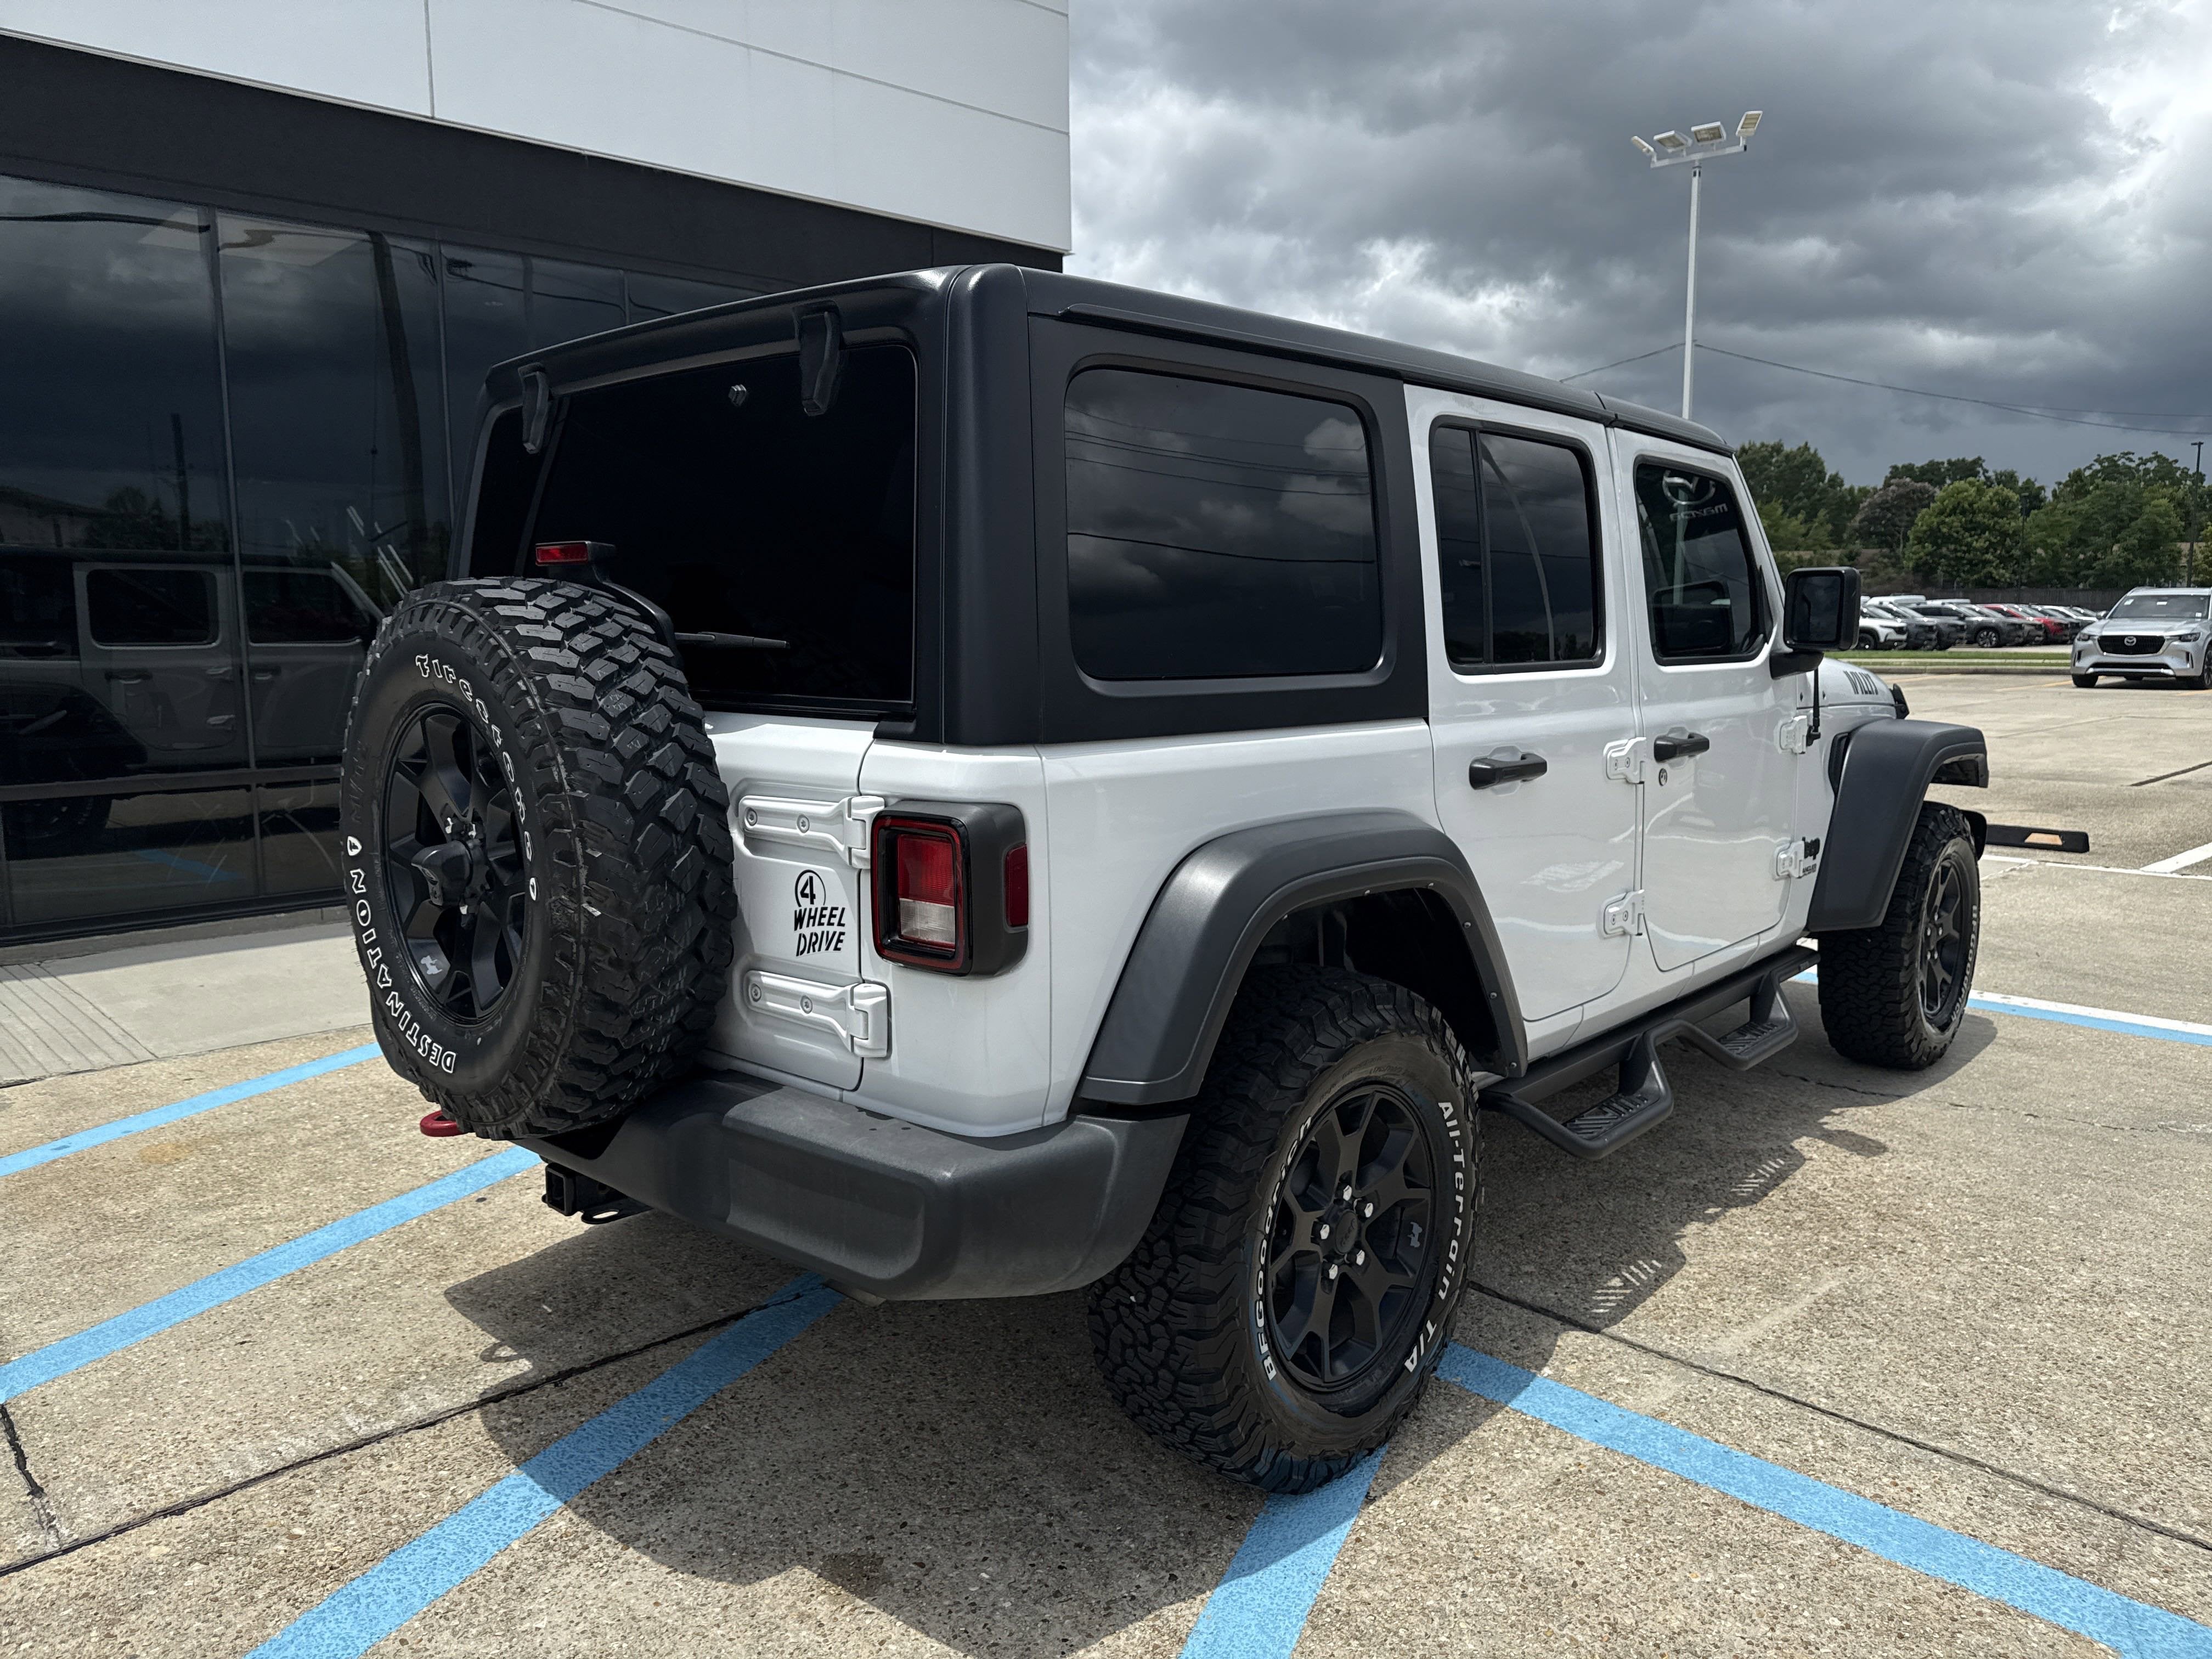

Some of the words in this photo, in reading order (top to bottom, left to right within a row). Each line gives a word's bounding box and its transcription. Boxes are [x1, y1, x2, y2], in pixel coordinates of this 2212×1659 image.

[415, 654, 532, 861] Firestone
[800, 876, 816, 905] 4
[794, 906, 845, 931] WHEEL
[796, 930, 845, 956] DRIVE
[351, 868, 456, 1074] DESTINATION
[1438, 1101, 1465, 1300] All-Terrain
[1404, 1320, 1437, 1372] T/A
